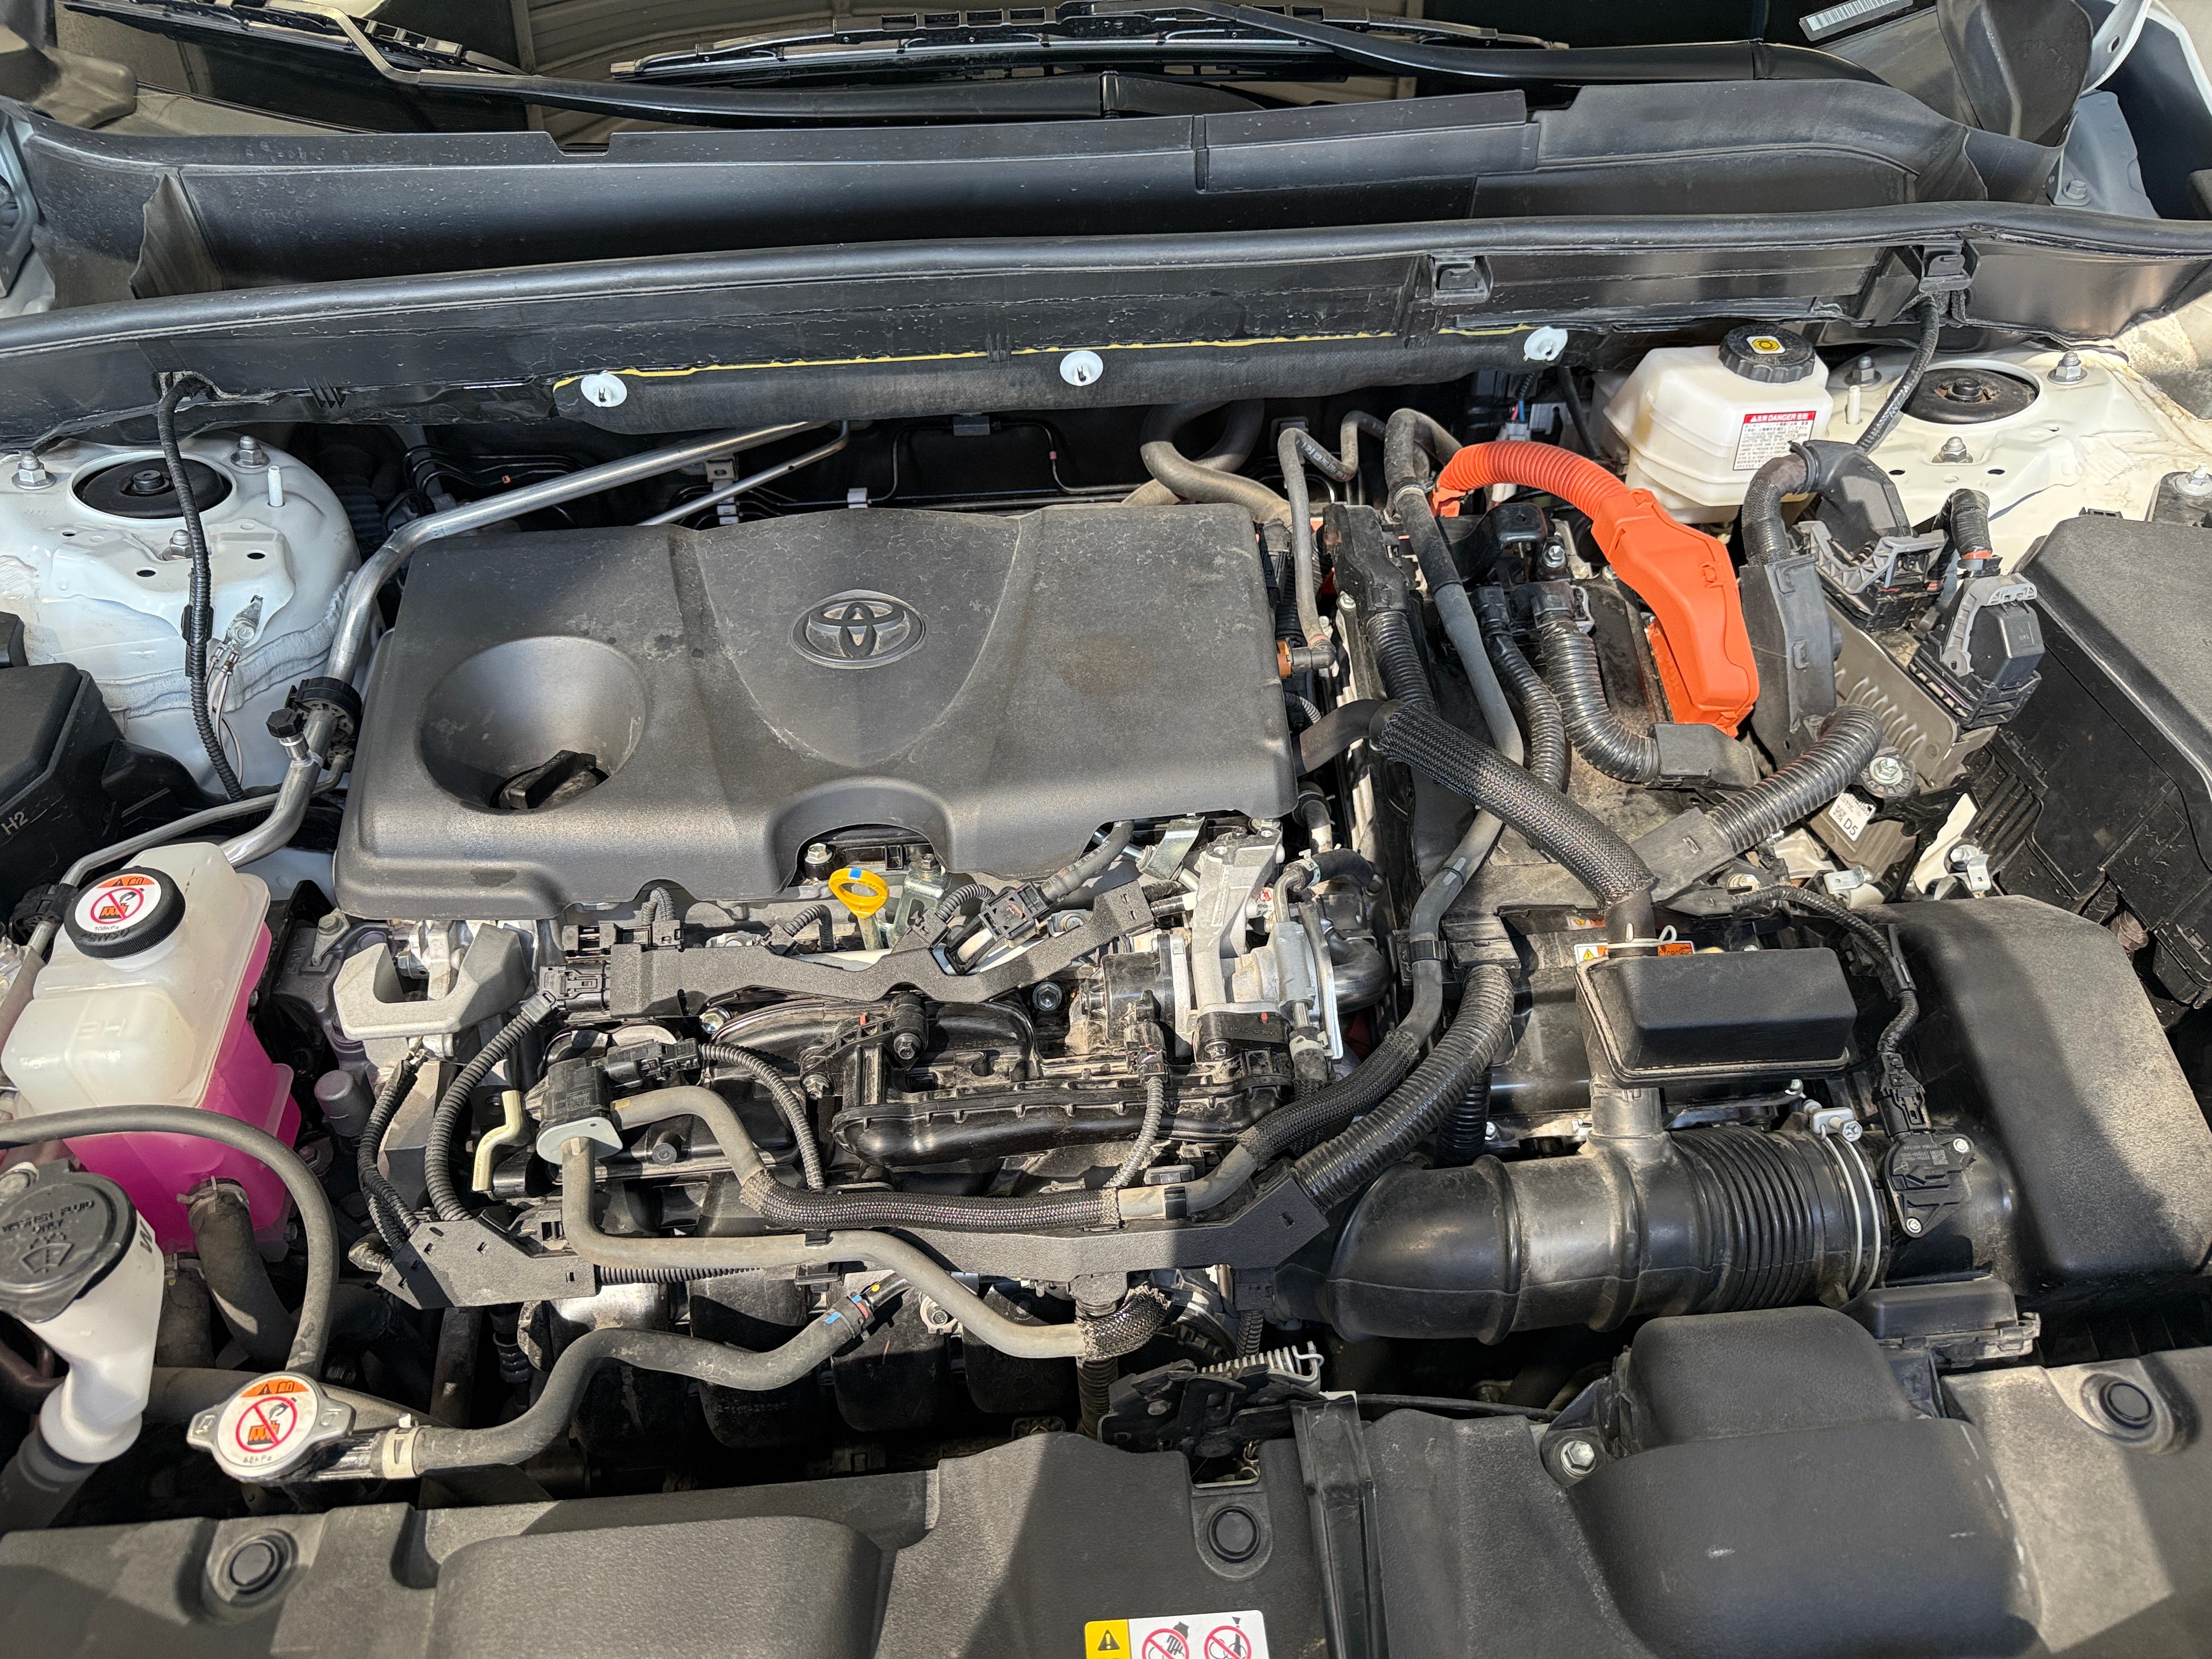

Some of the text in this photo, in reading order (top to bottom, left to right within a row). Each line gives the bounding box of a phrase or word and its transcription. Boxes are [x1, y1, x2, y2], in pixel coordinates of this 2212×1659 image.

[1, 811, 29, 835] H2
[1843, 817, 1858, 835] D5
[60, 1200, 95, 1217] FLUID
[32, 1218, 64, 1234] ONLY
